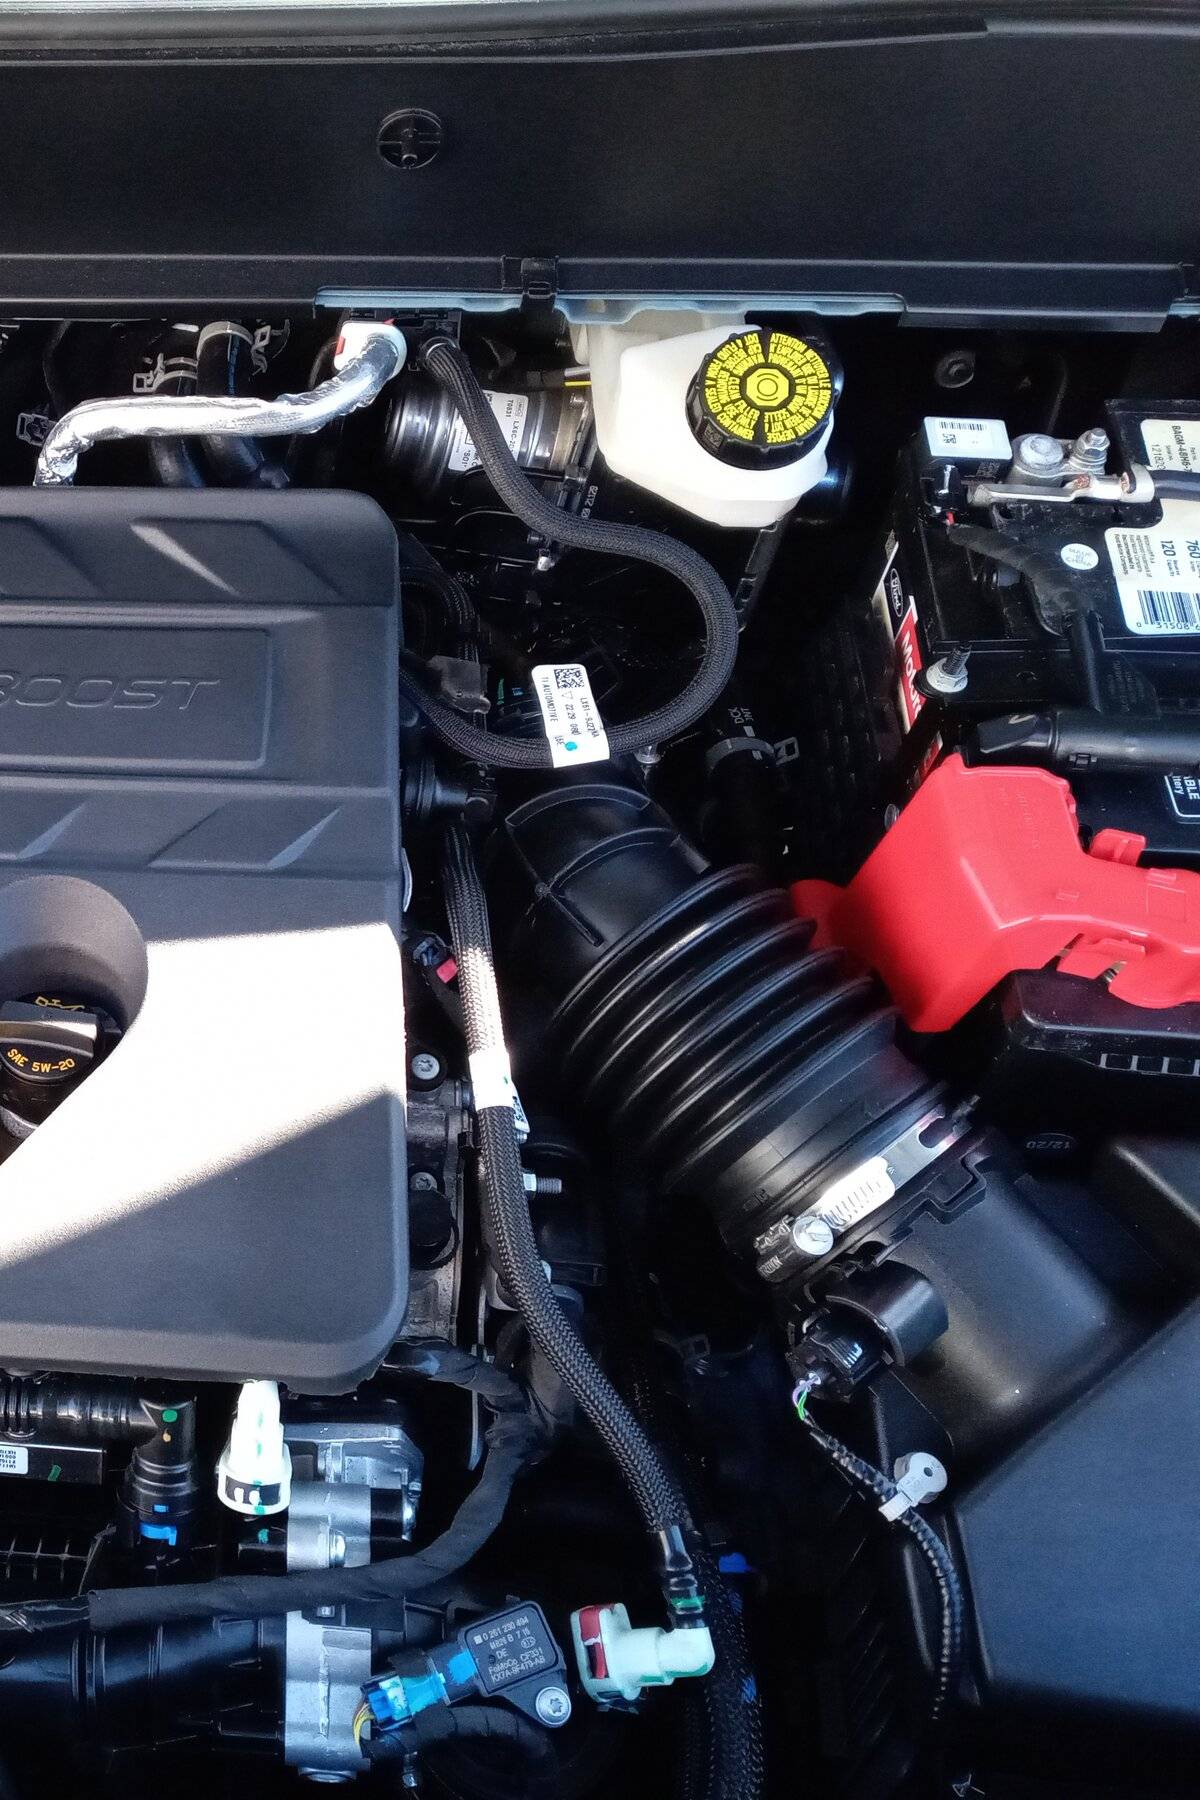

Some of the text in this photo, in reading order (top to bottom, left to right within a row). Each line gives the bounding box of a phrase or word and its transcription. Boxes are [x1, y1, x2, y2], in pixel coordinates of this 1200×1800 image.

[742, 333, 758, 345] DOT
[716, 342, 738, 361] FLUID
[746, 343, 761, 355] CAP
[706, 358, 723, 378] FROM
[722, 348, 747, 370] BEFORE
[727, 375, 740, 401] CLEAN
[819, 378, 831, 387] LE
[705, 387, 721, 414] SEALED
[732, 399, 759, 421] FILLER
[714, 412, 754, 440] CONTAINER
[733, 414, 756, 430] ONLY
[771, 421, 784, 432] DOT
[1160, 540, 1177, 557] 120
[1185, 540, 1200, 559] 760
[542, 684, 559, 722] AUTOMOTIVE
[7, 1048, 76, 1073] SAE 5W-20
[496, 1648, 509, 1660] DE
